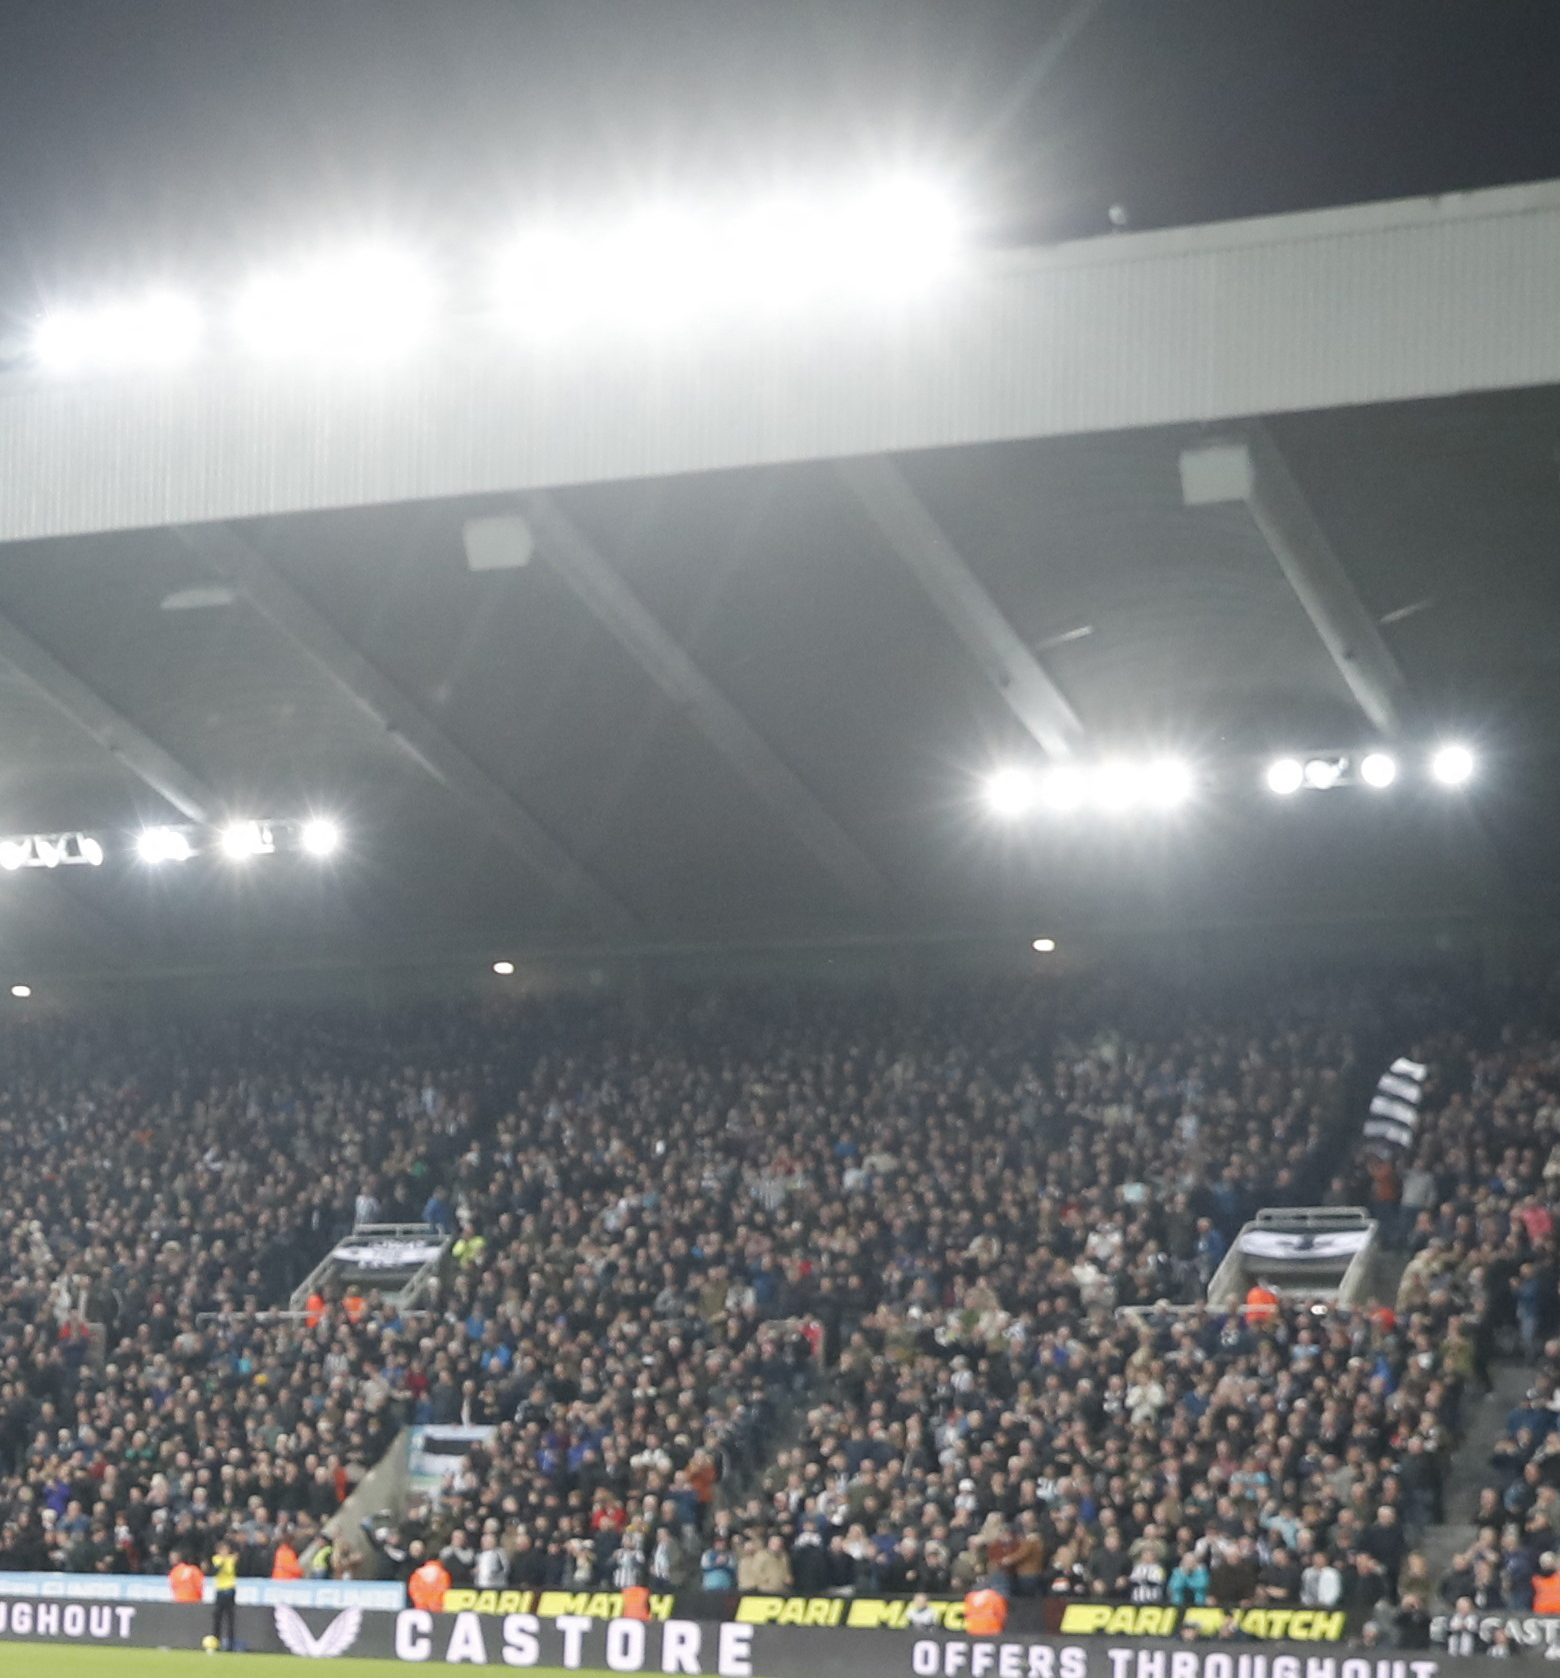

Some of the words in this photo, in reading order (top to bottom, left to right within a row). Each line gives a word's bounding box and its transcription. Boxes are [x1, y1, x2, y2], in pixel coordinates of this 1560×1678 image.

[444, 1588, 534, 1615] PARI
[537, 1591, 674, 1621] MATH
[735, 1596, 844, 1627] PARI
[847, 1598, 967, 1632] MTC
[1061, 1603, 1177, 1636] PARI
[395, 1608, 754, 1677] CASTORE
